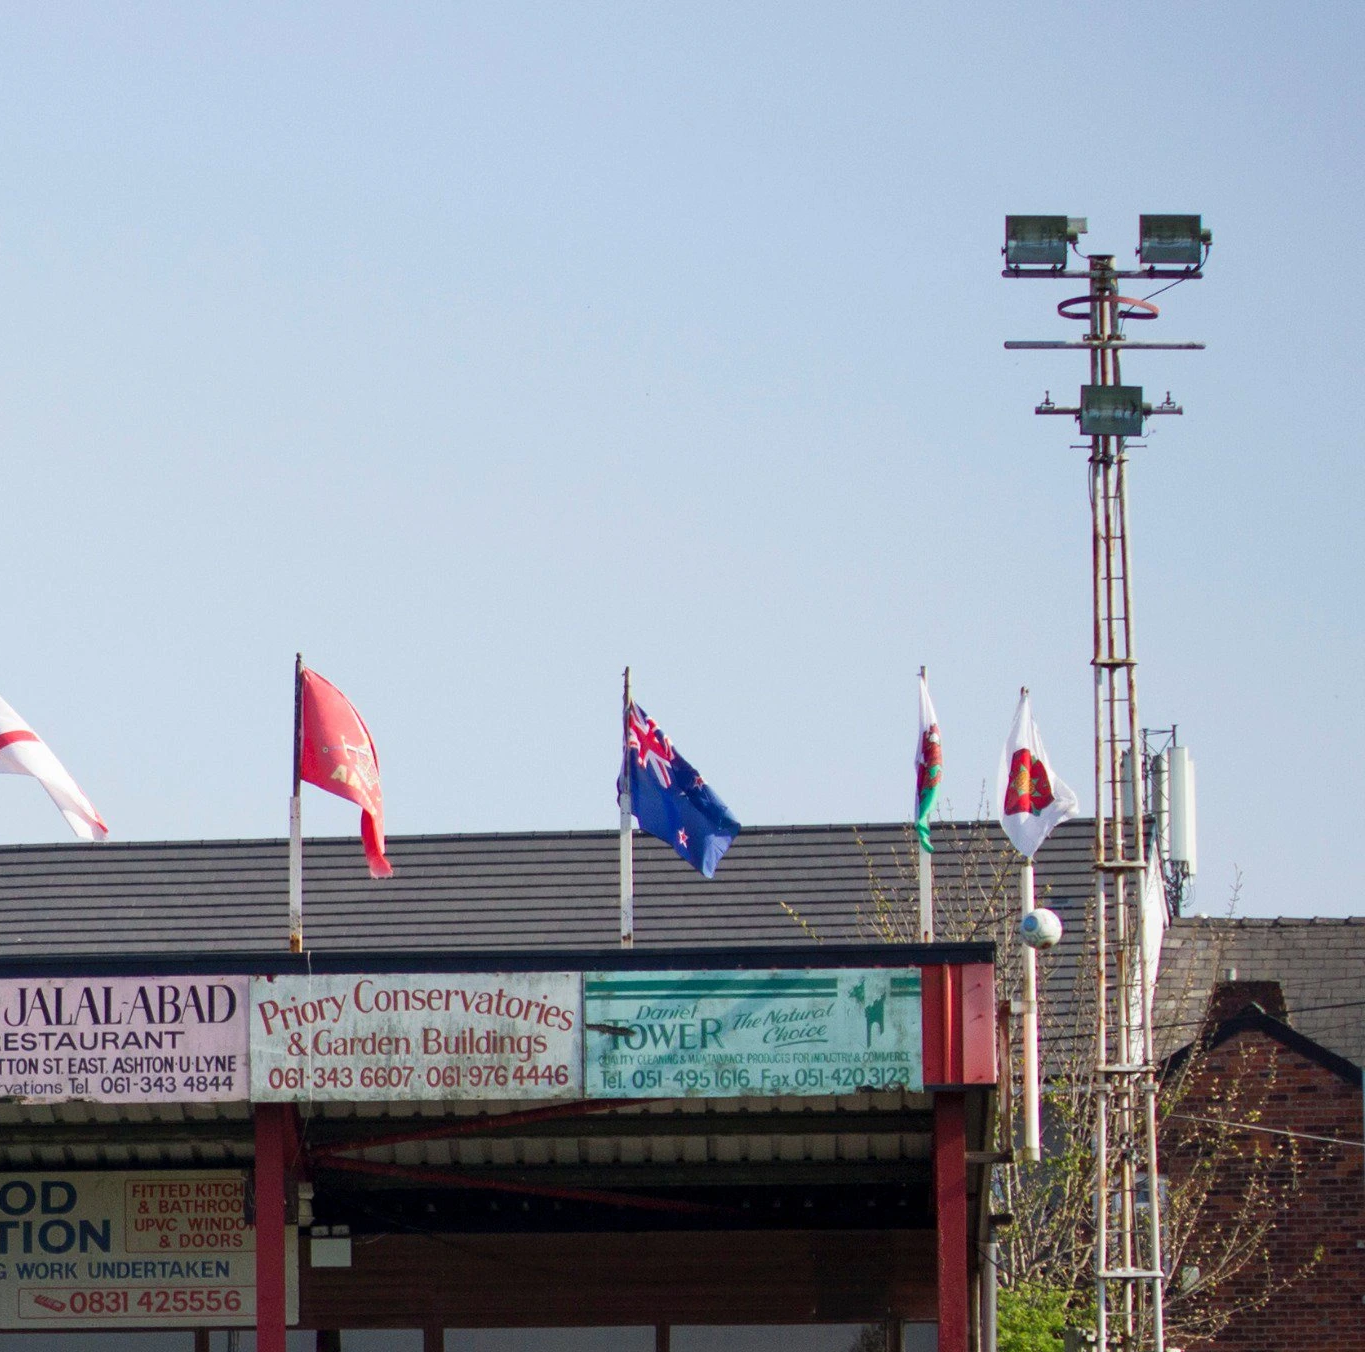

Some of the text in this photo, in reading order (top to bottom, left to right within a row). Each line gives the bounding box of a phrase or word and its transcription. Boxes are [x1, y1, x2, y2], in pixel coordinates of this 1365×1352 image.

[257, 979, 574, 1036] Priory Conservatories
[636, 1003, 698, 1020] Daniel
[733, 1002, 835, 1031] The Natural
[603, 1017, 726, 1051] TOWER
[762, 1024, 827, 1046] Choice
[287, 1027, 548, 1063] & Garden Buildings
[43, 1058, 64, 1075] ST.
[638, 1054, 678, 1065] CLEANING
[747, 1053, 790, 1063] PRODUCTS
[793, 1053, 809, 1063] FOR
[811, 1052, 852, 1063] INDUSTRY
[69, 1078, 91, 1094] Tel.
[101, 1076, 177, 1093] 061-343
[184, 1075, 234, 1092] 4844
[512, 1064, 569, 1087] 4446
[600, 1070, 626, 1089] Tel.
[632, 1069, 710, 1089] 051-495
[714, 1069, 750, 1088] 1616
[795, 1068, 866, 1087] 051-420
[869, 1067, 910, 1085] 3123
[132, 1183, 245, 1198] FITTED KITCH
[138, 1199, 243, 1214] & BATHROO
[134, 1217, 178, 1232] UPVC
[159, 1233, 244, 1248] & DOORS
[16, 1261, 78, 1280] WORK
[87, 1260, 231, 1279] UNDERTAKEN
[69, 1289, 242, 1314] 0831 425556
